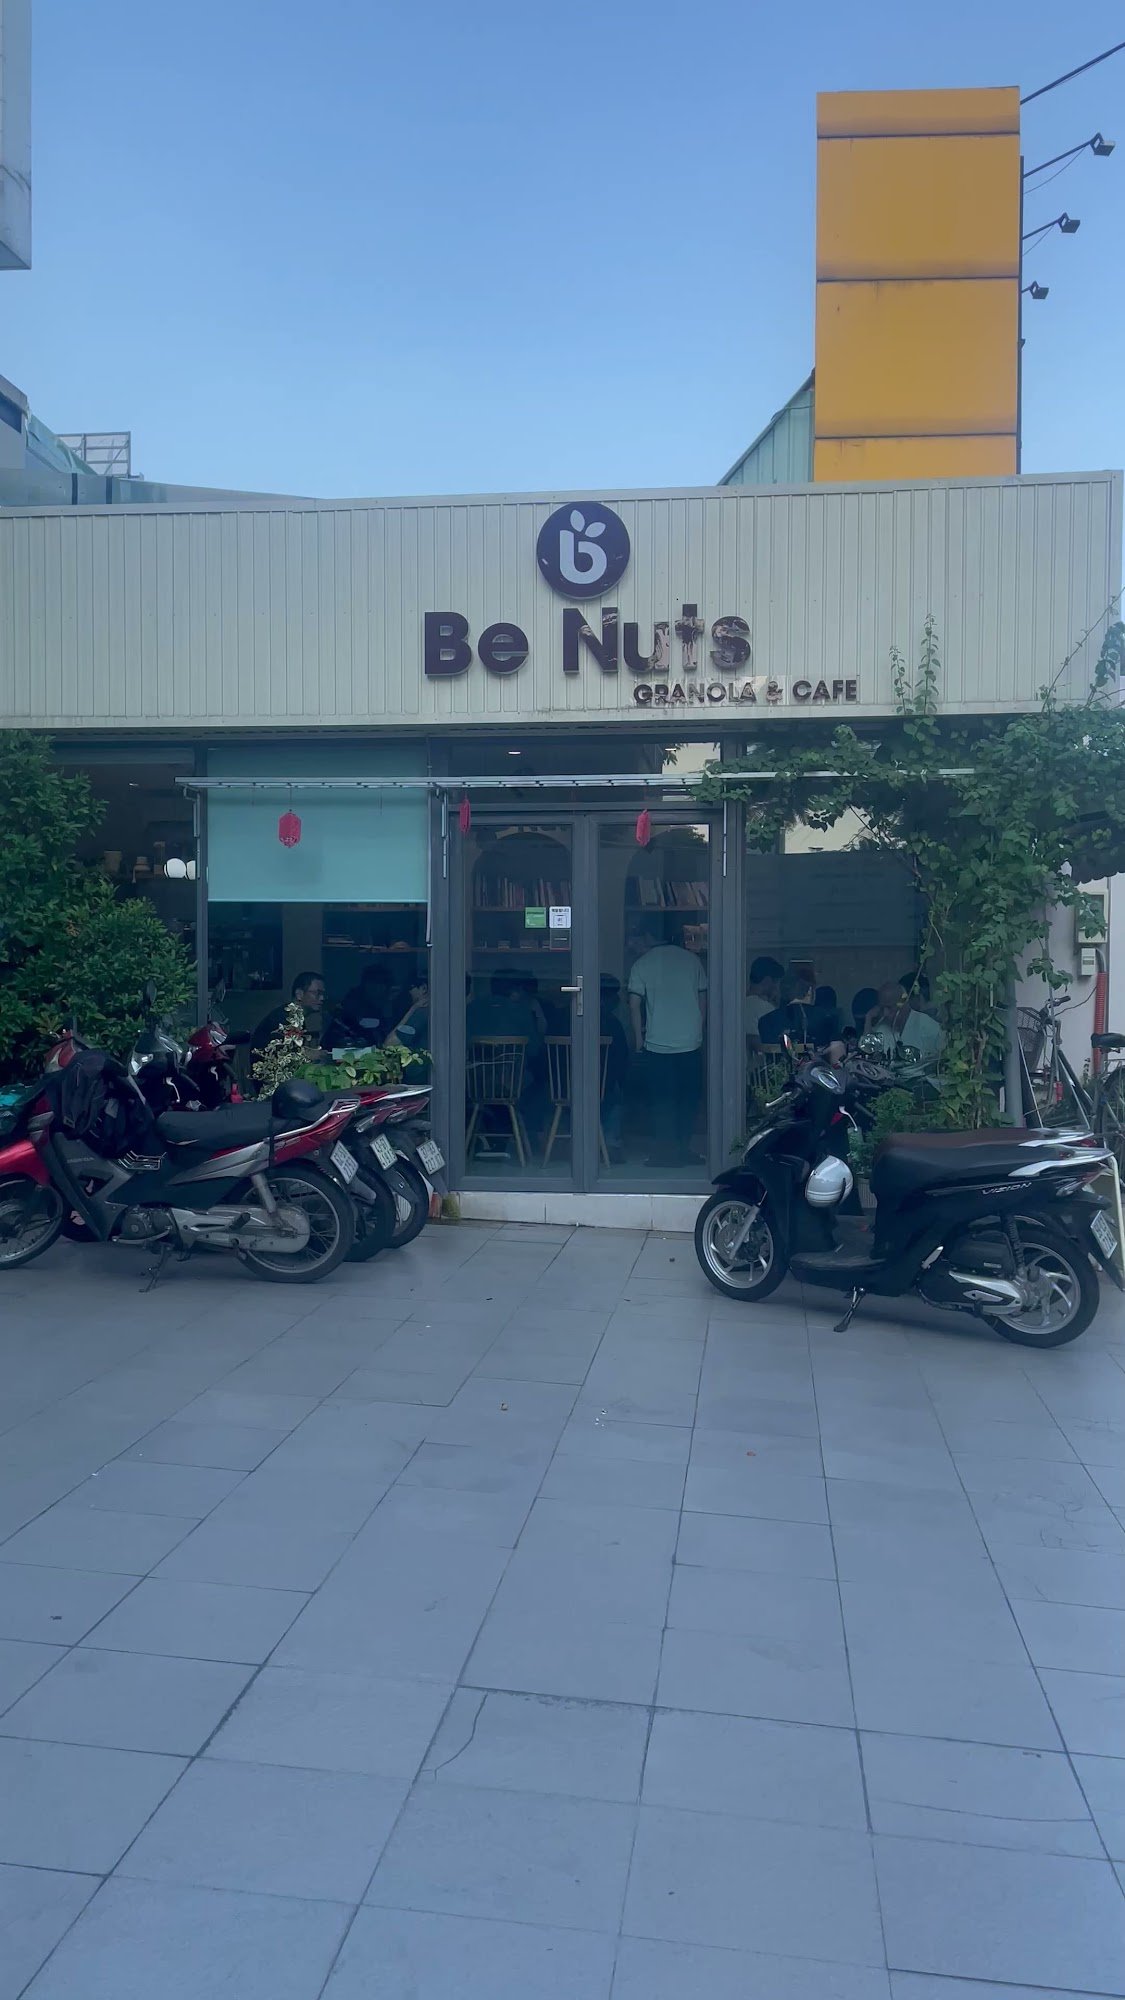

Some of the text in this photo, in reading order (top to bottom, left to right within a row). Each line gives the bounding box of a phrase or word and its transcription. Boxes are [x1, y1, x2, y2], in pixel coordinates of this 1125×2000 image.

[425, 604, 751, 674] Be Nuts
[633, 679, 857, 704] GRANOLA & CAFE
[982, 1182, 1032, 1195] VISION
